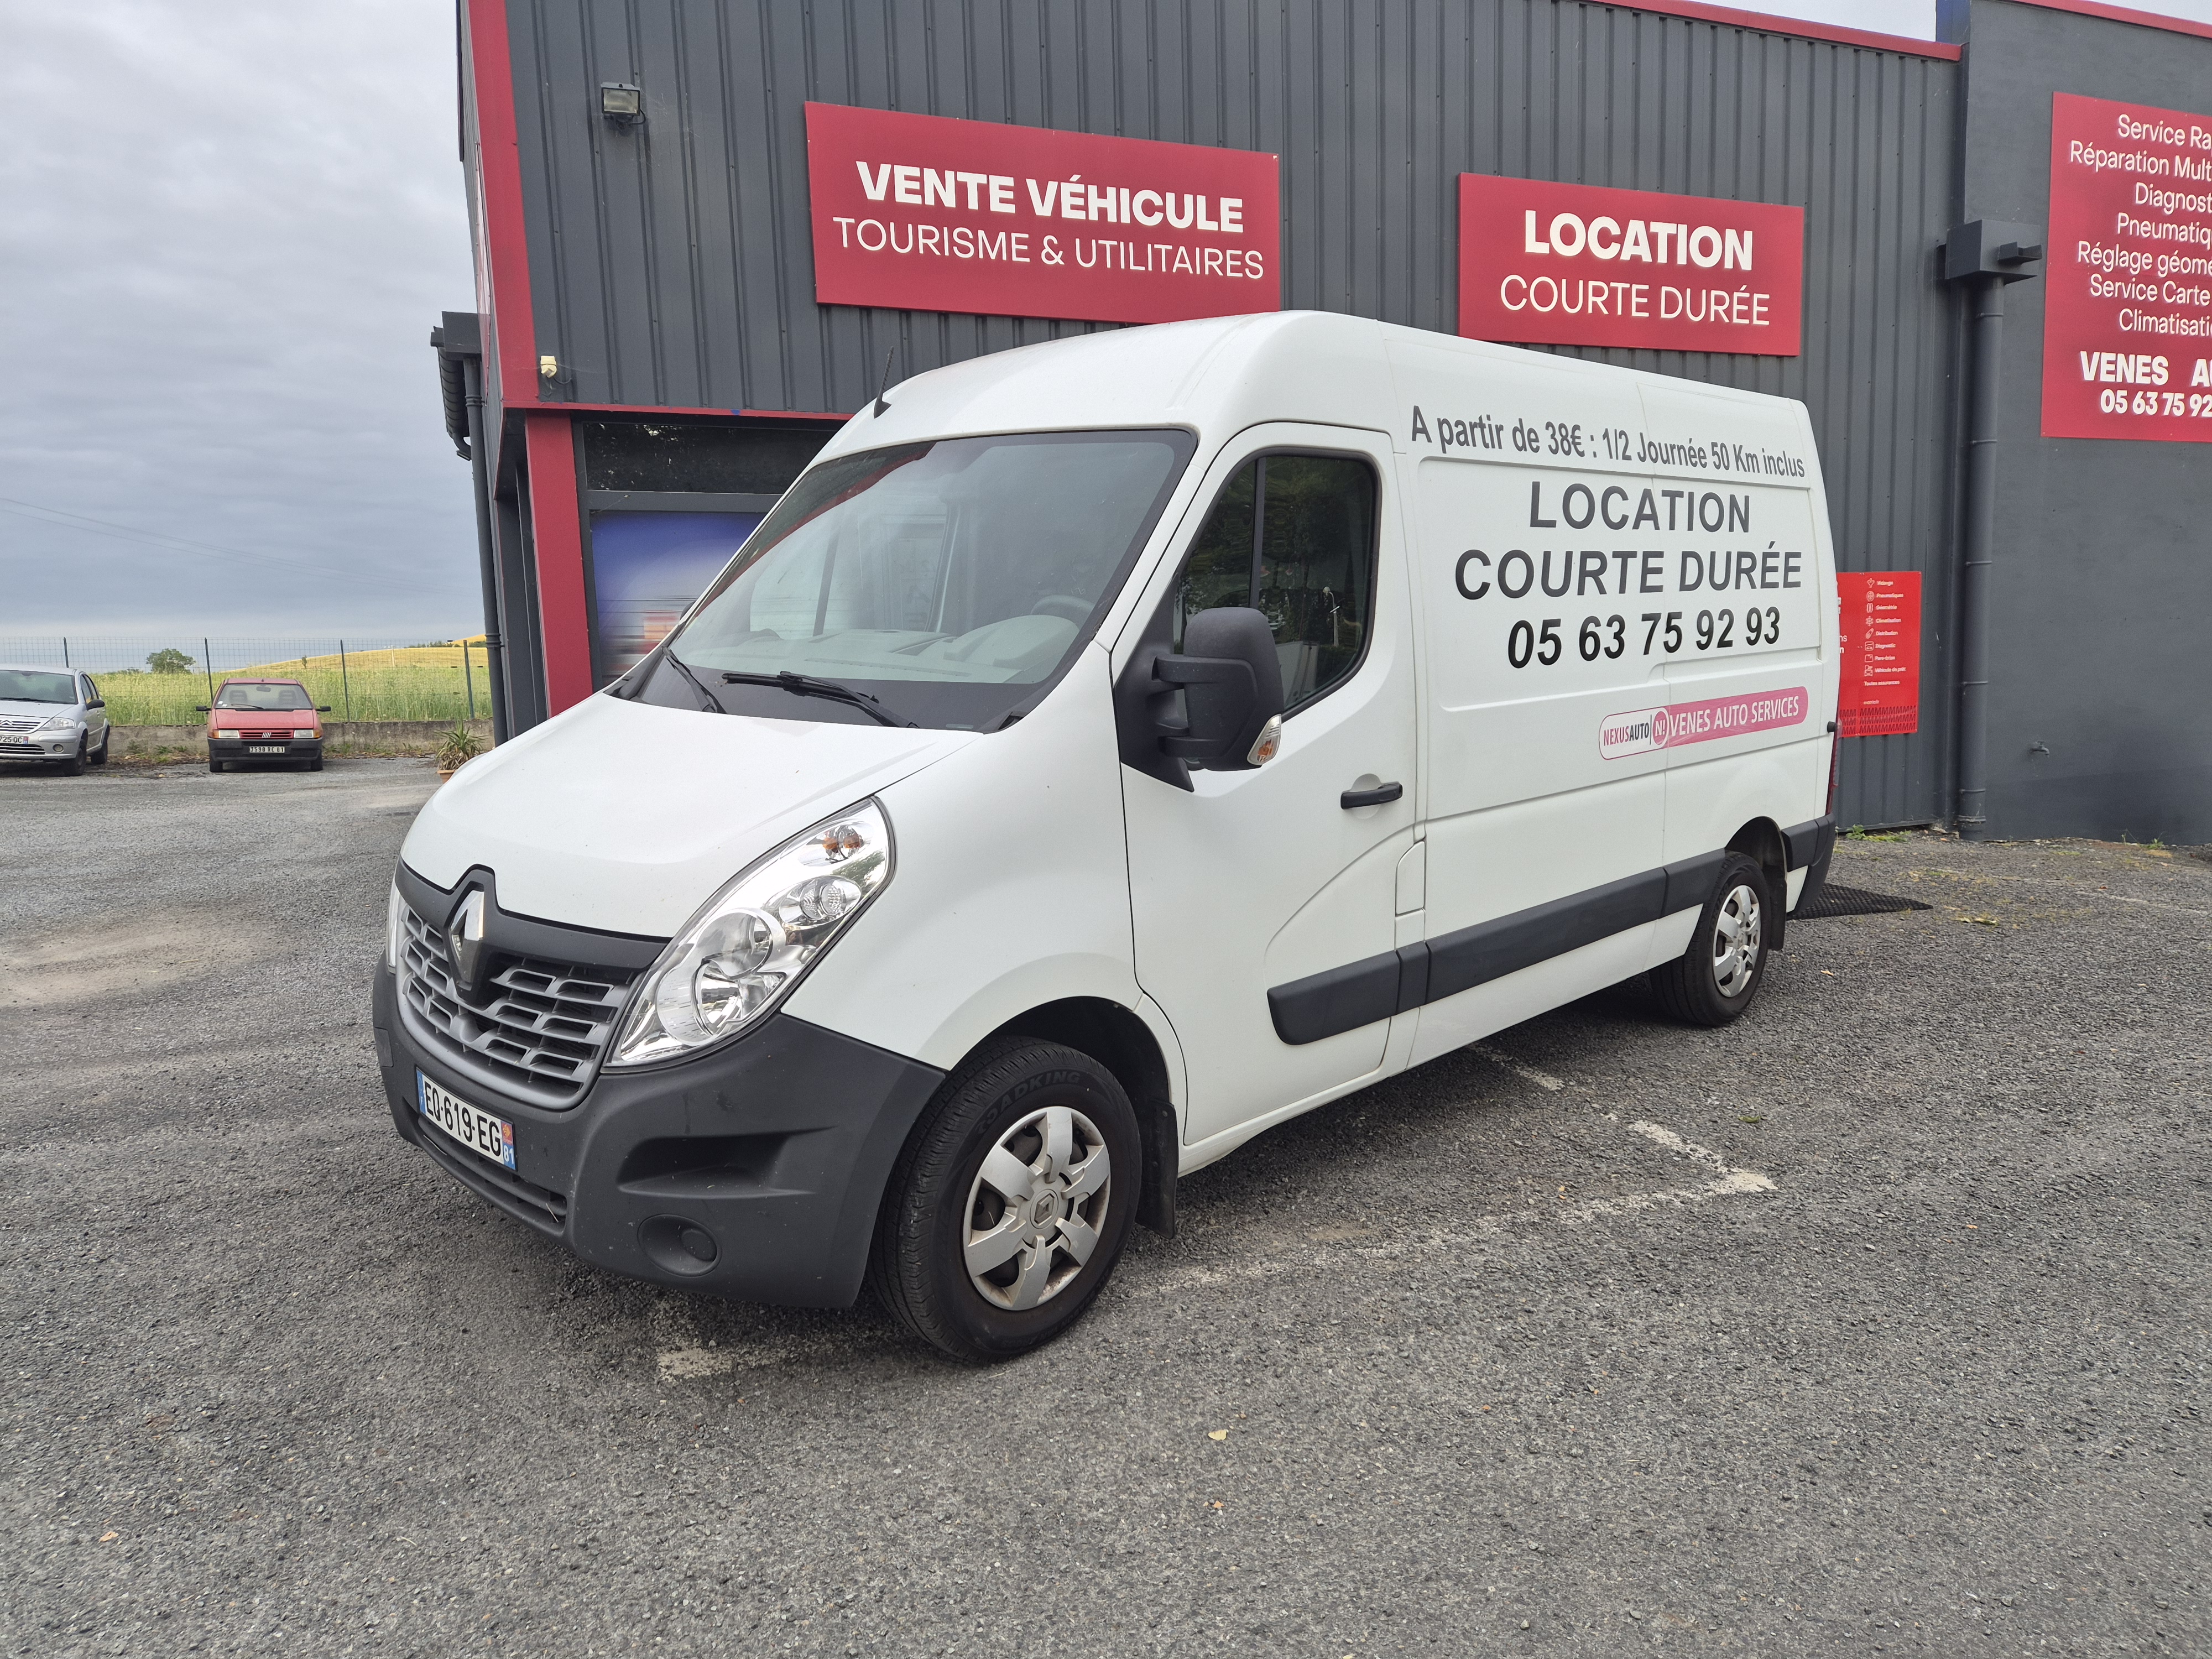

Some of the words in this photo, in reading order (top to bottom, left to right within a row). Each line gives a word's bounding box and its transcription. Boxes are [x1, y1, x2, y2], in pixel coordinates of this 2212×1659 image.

[2070, 140, 2169, 176] Réparation
[2174, 155, 2212, 182] Mult
[2118, 114, 2185, 146] Service
[2190, 126, 2212, 157] Ra
[855, 160, 1015, 213] VENTE
[1026, 175, 1243, 232] VÉHICULE
[833, 216, 1030, 262] TOURISME
[1041, 235, 1064, 265] &
[1076, 238, 1264, 279] UTILITAIRES
[1525, 210, 1752, 270] LOCATION
[2078, 241, 2153, 273] Réglage
[2117, 212, 2212, 251] Pneumatiq
[1501, 274, 1649, 317] COURTE
[1661, 285, 1770, 325] DURÉE
[2090, 274, 2158, 301] Service
[2163, 280, 2210, 306] Carte
[2119, 307, 2212, 336] Climatisati
[2080, 351, 2169, 385] VENES
[2191, 358, 2212, 387] A
[2100, 389, 2128, 415] 05
[2132, 391, 2158, 415] 63
[2163, 393, 2185, 416] 75
[2190, 393, 2212, 417] 92
[1411, 405, 1432, 443] A
[1437, 414, 1504, 453] partir
[1512, 418, 1538, 453] de
[1545, 421, 1585, 457] 38€
[1603, 428, 1632, 461] 1/2
[1637, 432, 1707, 468] Journée
[1711, 441, 1730, 471] 50
[1734, 445, 1760, 474] Km
[1762, 448, 1805, 478] inclus
[1530, 481, 1750, 533] LOCATION
[1455, 549, 1665, 600] COURTE
[1679, 541, 1802, 592] DURÉE
[1508, 619, 1562, 669] 05
[1579, 614, 1625, 661] 63
[1641, 611, 1682, 655] 75
[1696, 608, 1734, 650] 92
[1746, 606, 1780, 645] 93
[1604, 722, 1649, 747] NEXUSAUTO
[1670, 709, 1710, 737] VENES
[1714, 704, 1748, 729] AUTO
[1751, 696, 1799, 723] SERVICES
[424, 1081, 501, 1156] EQ-619-EG
[503, 1145, 514, 1164] 81
